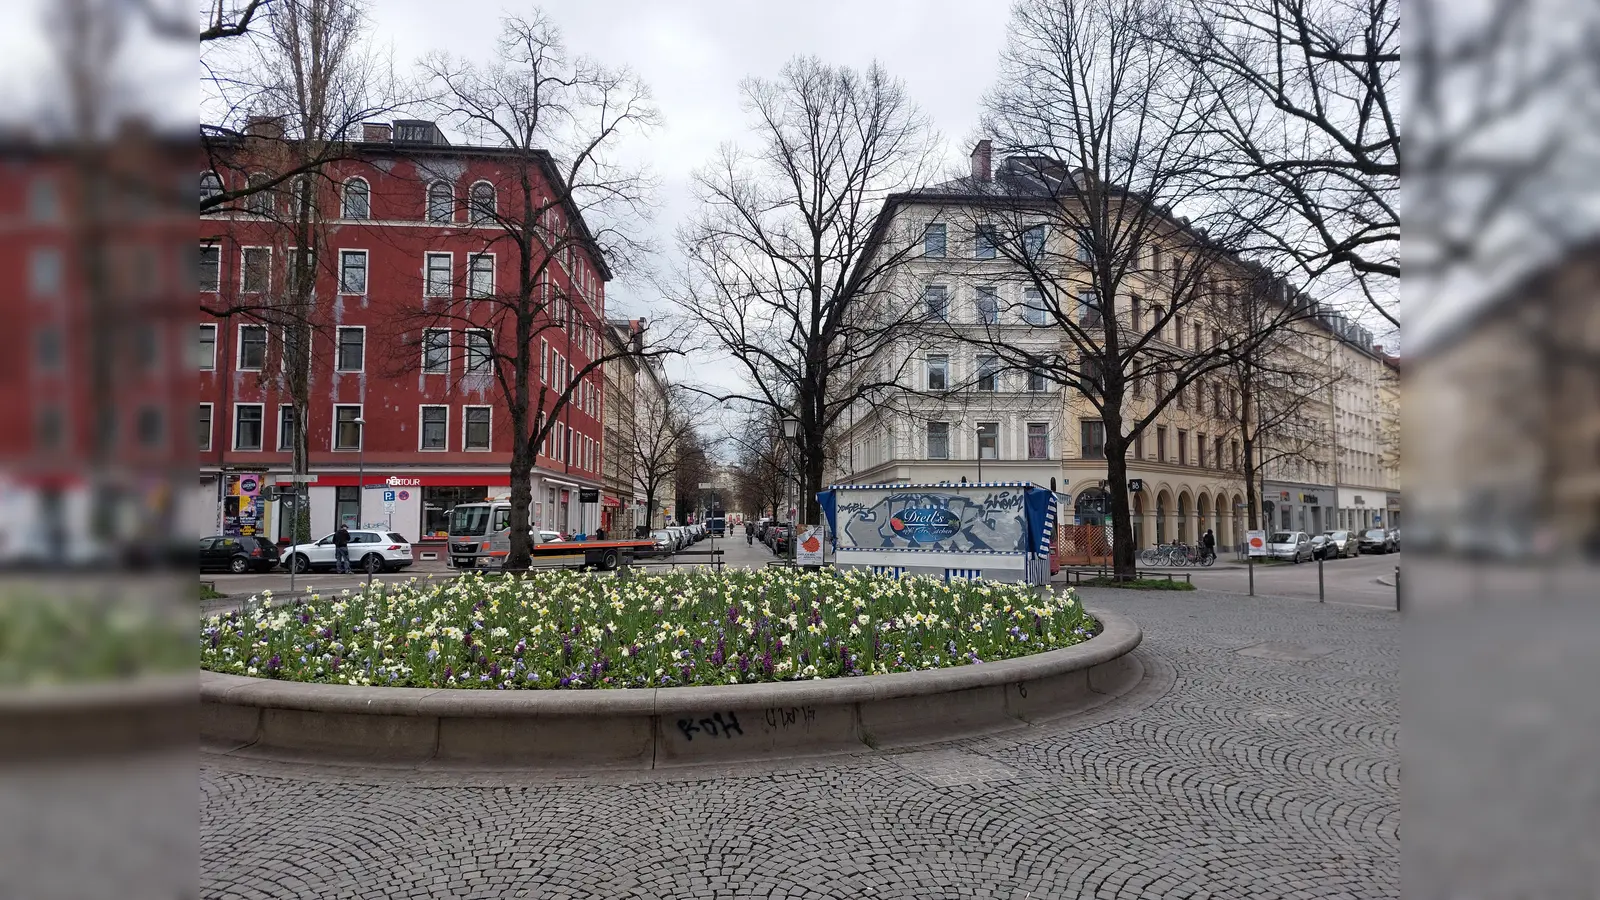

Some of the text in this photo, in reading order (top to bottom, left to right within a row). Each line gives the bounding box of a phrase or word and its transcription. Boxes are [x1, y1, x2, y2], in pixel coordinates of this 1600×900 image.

[386, 476, 421, 486] DERTOUR
[385, 492, 392, 501] P
[904, 510, 945, 524] Dietl's
